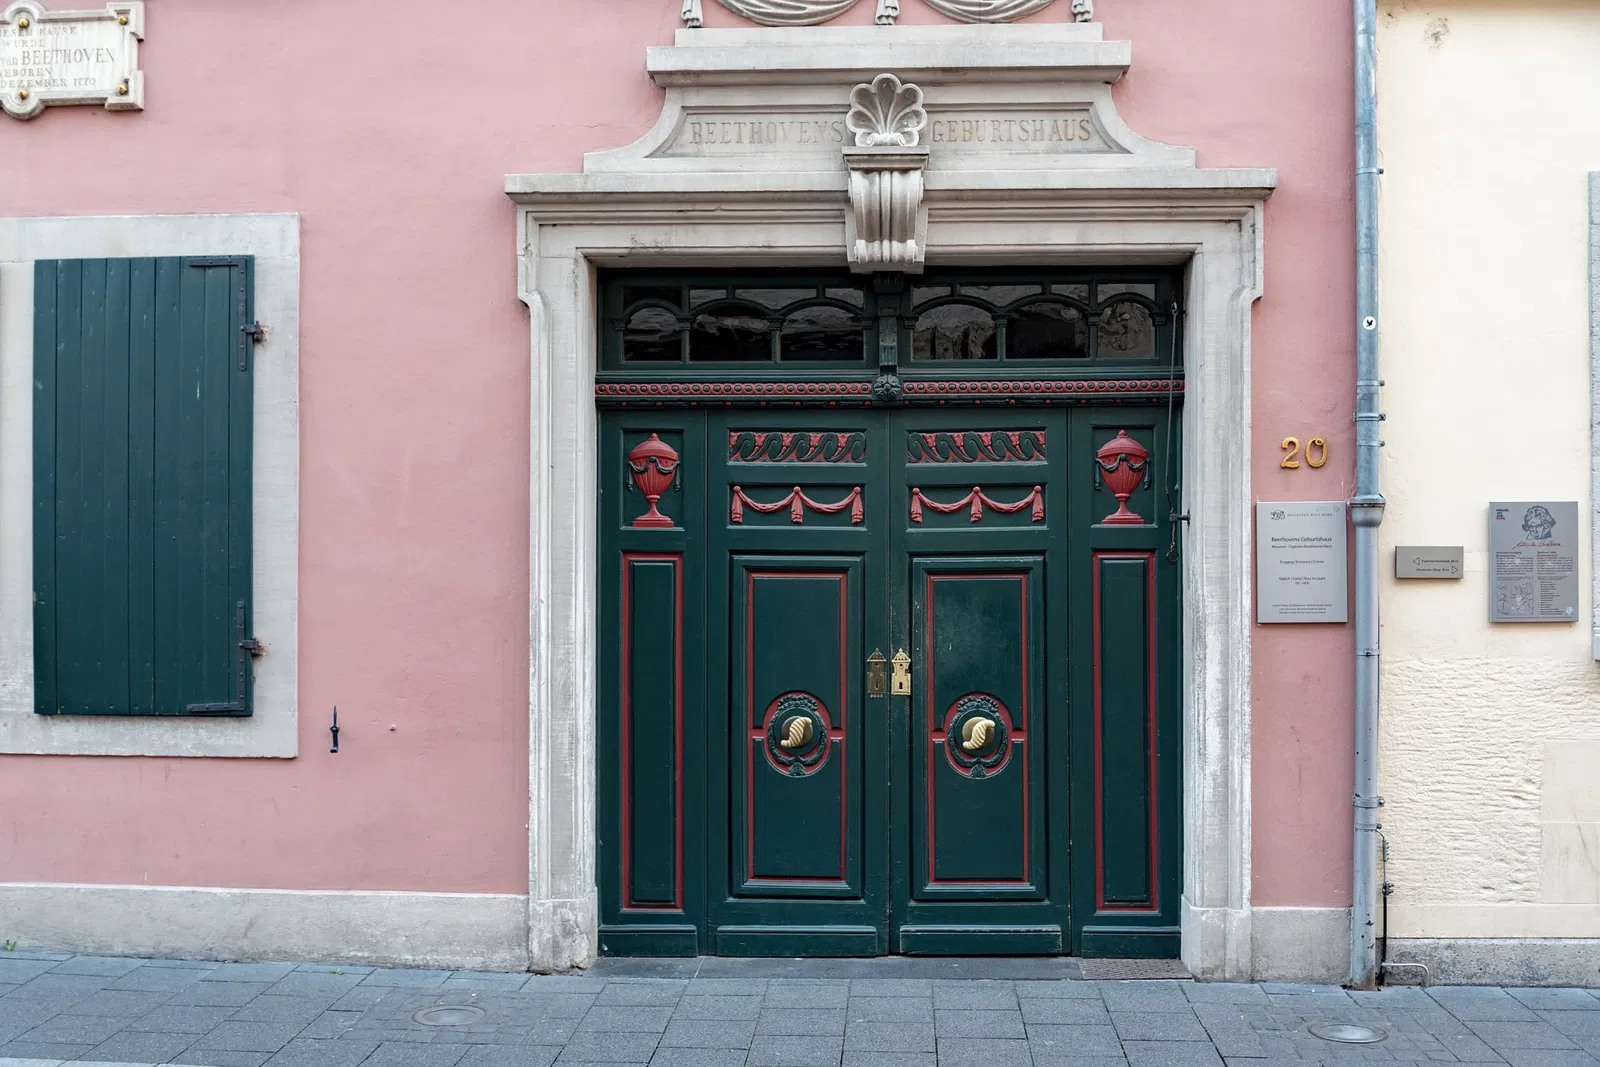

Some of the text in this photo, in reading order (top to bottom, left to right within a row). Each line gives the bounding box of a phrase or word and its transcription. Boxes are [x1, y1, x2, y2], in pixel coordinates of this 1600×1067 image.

[39, 26, 77, 36] HAUSE
[22, 47, 115, 66] BEETHOVEN
[0, 67, 53, 78] EBOREN
[689, 118, 1092, 145] BEETHOVENS GEBURTSHAUS
[1280, 436, 1328, 469] 20
